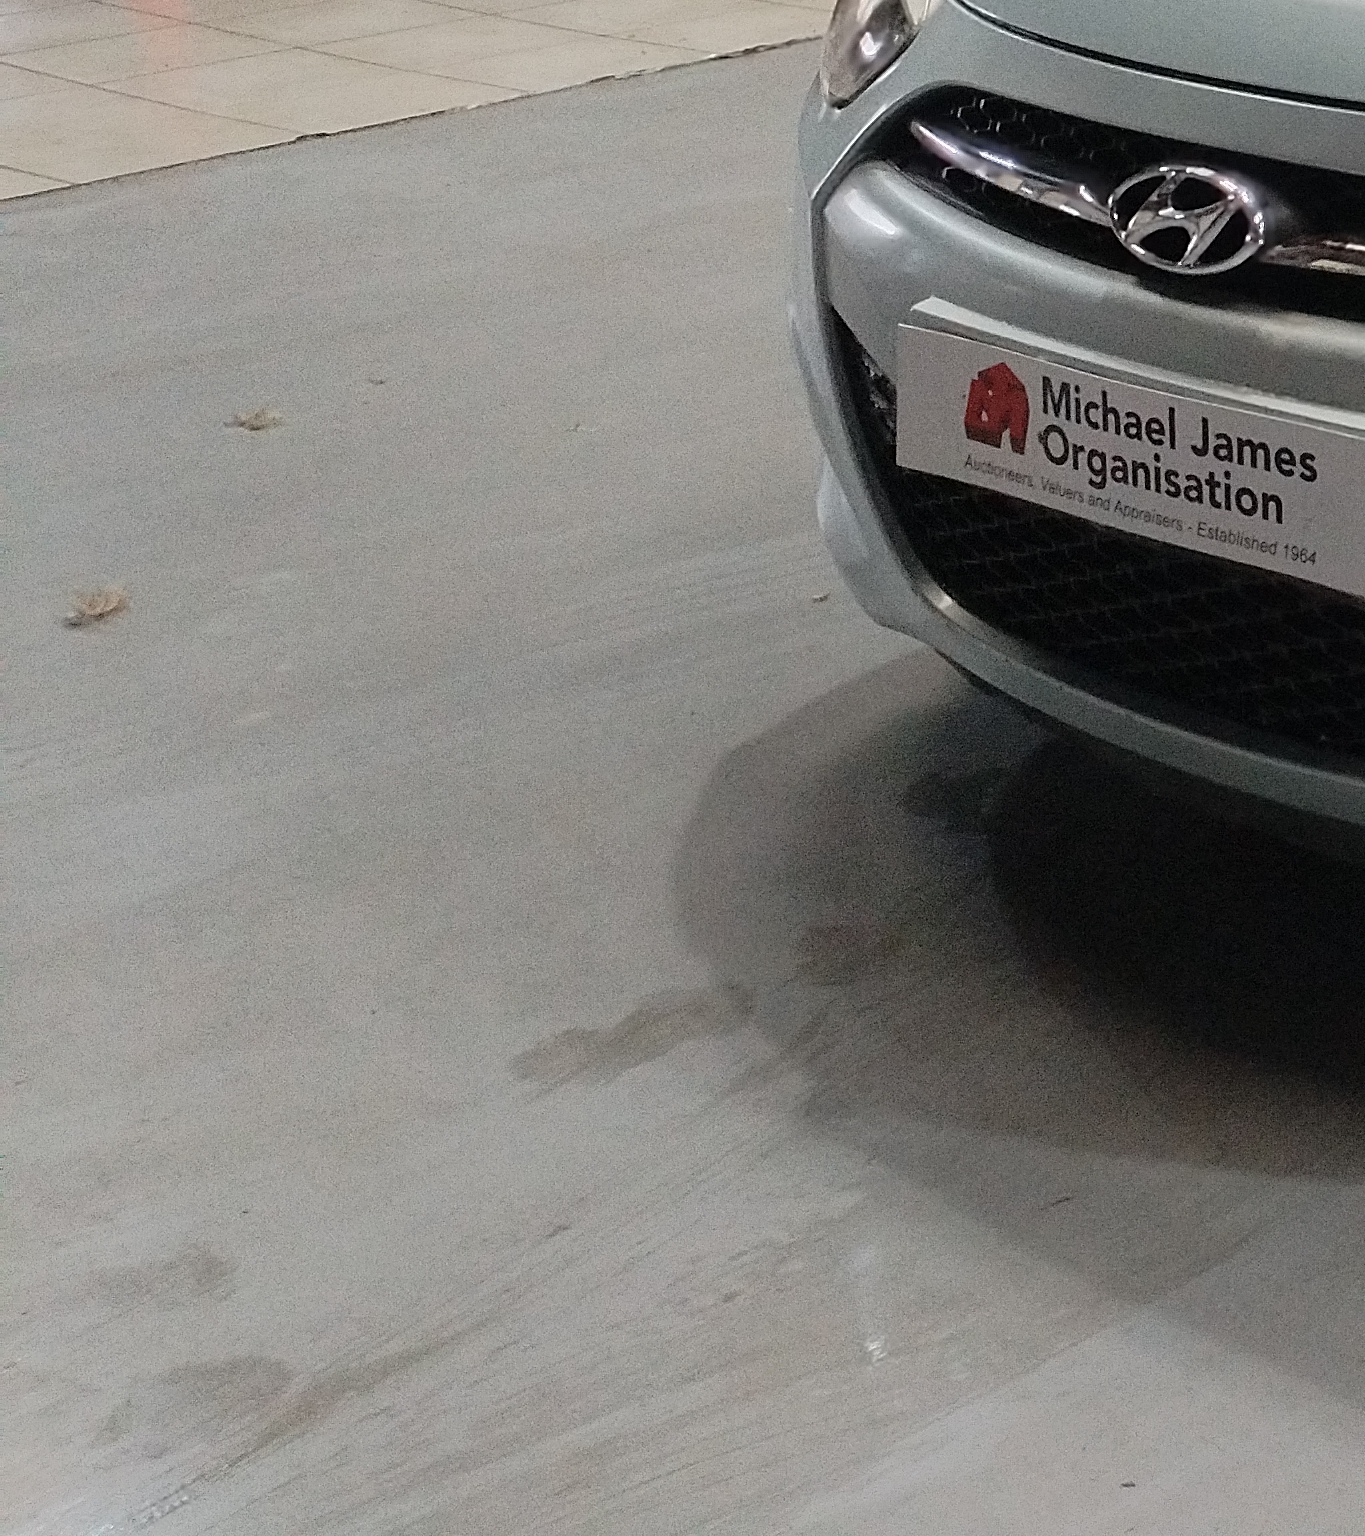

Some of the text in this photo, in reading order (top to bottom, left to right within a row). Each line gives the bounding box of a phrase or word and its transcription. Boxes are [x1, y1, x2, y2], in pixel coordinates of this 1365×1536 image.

[1042, 375, 1318, 482] Michael James
[1042, 424, 1284, 524] Organisation
[1041, 475, 1085, 504] Valuers
[1088, 494, 1111, 512] and
[1114, 500, 1184, 534] Appraisers
[1197, 521, 1277, 555] Established
[1283, 543, 1317, 566] 1964
